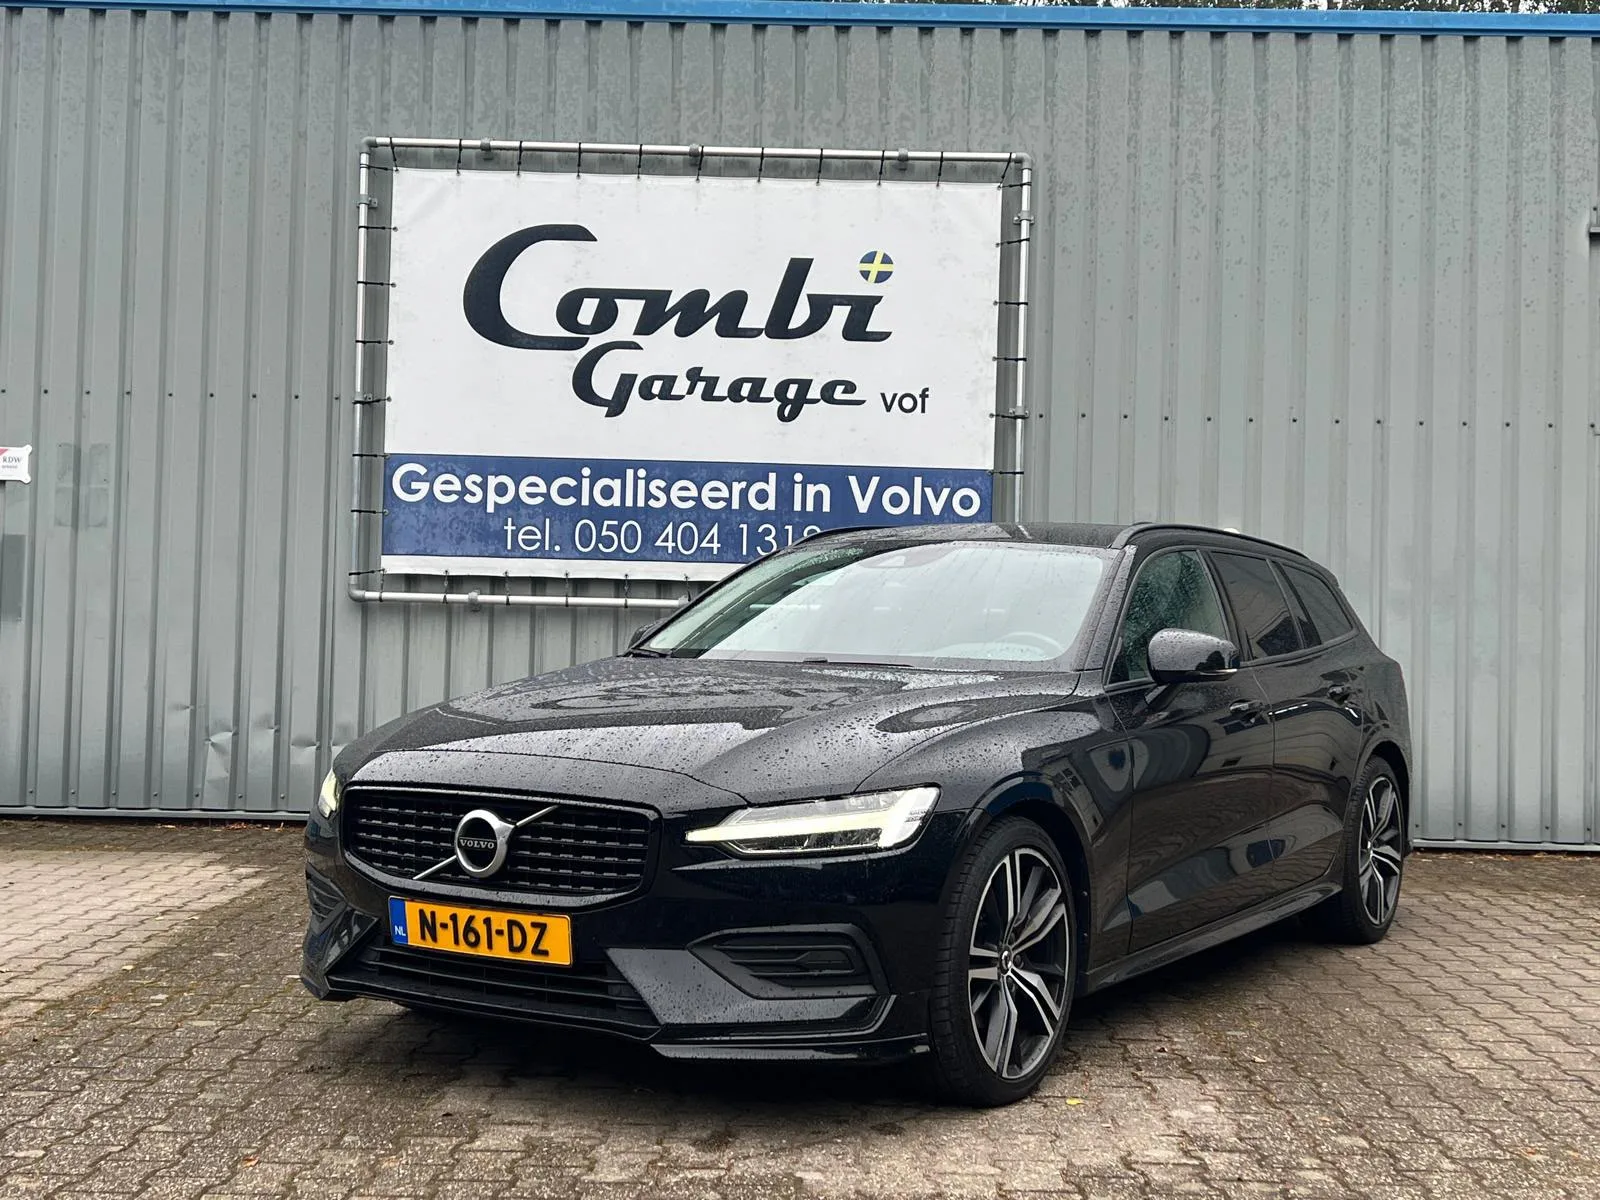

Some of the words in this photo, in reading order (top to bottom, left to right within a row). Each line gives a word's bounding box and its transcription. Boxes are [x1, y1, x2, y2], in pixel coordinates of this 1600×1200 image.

[463, 224, 894, 350] Combi
[572, 340, 867, 423] Garage
[881, 387, 930, 414] vof
[391, 463, 777, 513] Gespecialiseerd
[794, 472, 831, 513] in
[849, 474, 982, 518] Volvo
[504, 518, 560, 553] tel.
[574, 519, 643, 553] 050
[654, 521, 721, 556] 404
[460, 839, 495, 850] VOLVO
[394, 925, 406, 937] NL
[418, 908, 549, 957] N-161-DZ
